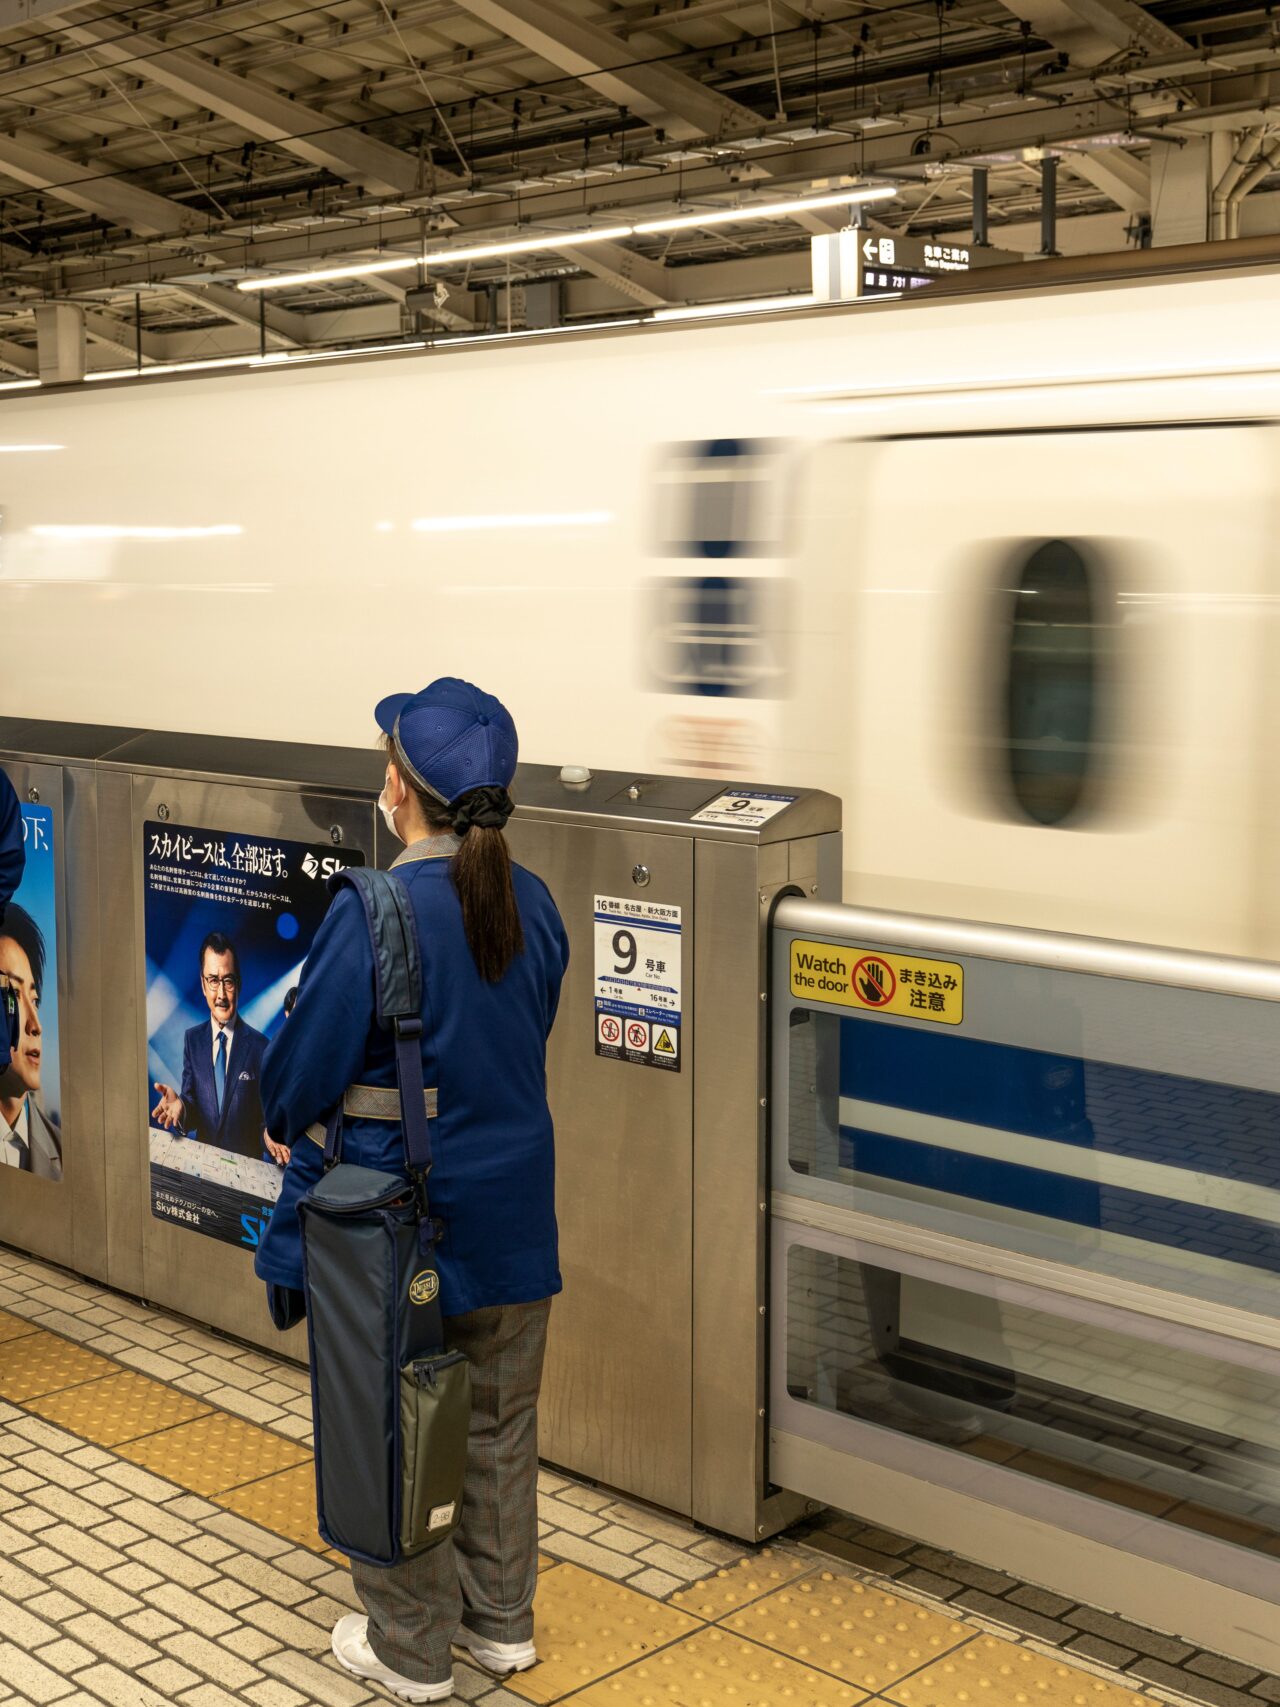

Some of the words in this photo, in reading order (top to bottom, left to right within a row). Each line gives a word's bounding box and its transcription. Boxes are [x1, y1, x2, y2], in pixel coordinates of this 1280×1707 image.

[725, 800, 750, 812] 9
[149, 832, 288, 879] スカイピースは、全部返す。
[321, 857, 351, 880] Sk
[612, 929, 638, 975] 9
[645, 958, 666, 974] 号車
[796, 952, 846, 976] Watch
[794, 972, 815, 988] the
[817, 976, 849, 993] door
[899, 968, 958, 991] まき込み
[910, 988, 946, 1012] 注意
